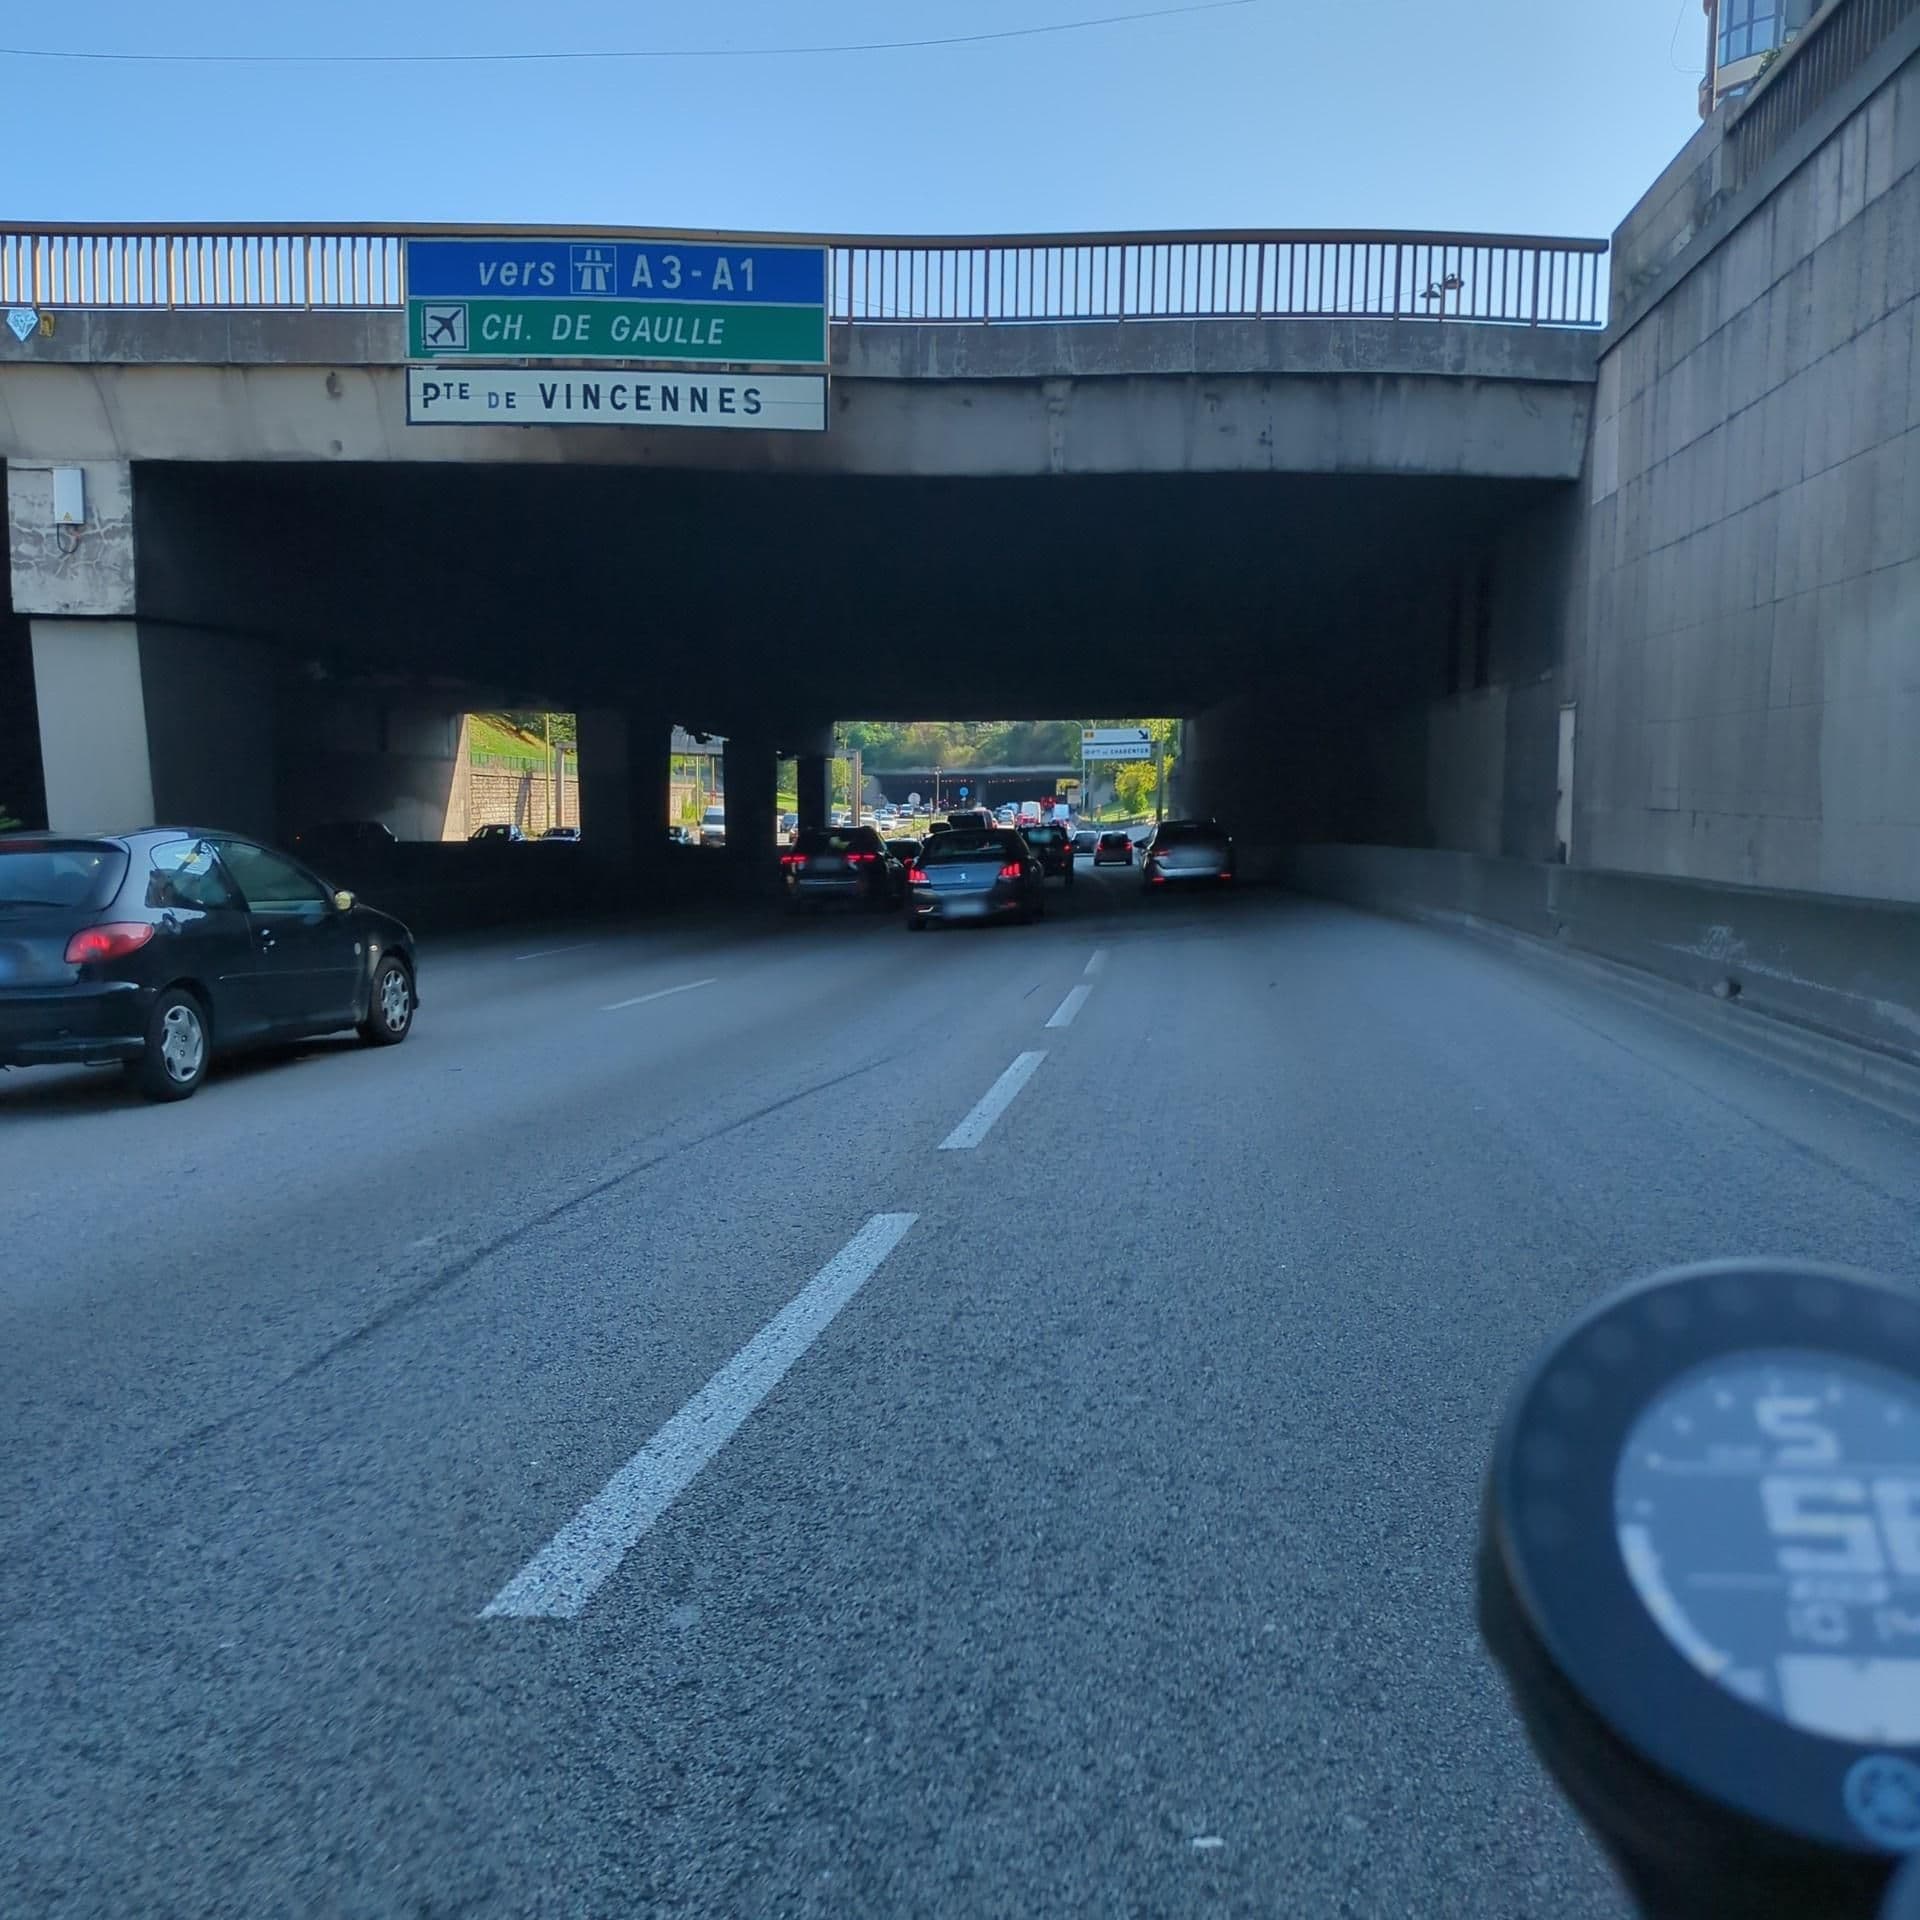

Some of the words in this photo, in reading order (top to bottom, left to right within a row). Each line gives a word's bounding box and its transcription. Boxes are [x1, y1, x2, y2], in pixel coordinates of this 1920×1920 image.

[479, 261, 556, 287] vers
[482, 314, 532, 341] CH.
[552, 314, 591, 341] DE
[611, 316, 725, 345] GAULLE
[488, 391, 516, 409] DE
[539, 383, 762, 415] VINCENNES
